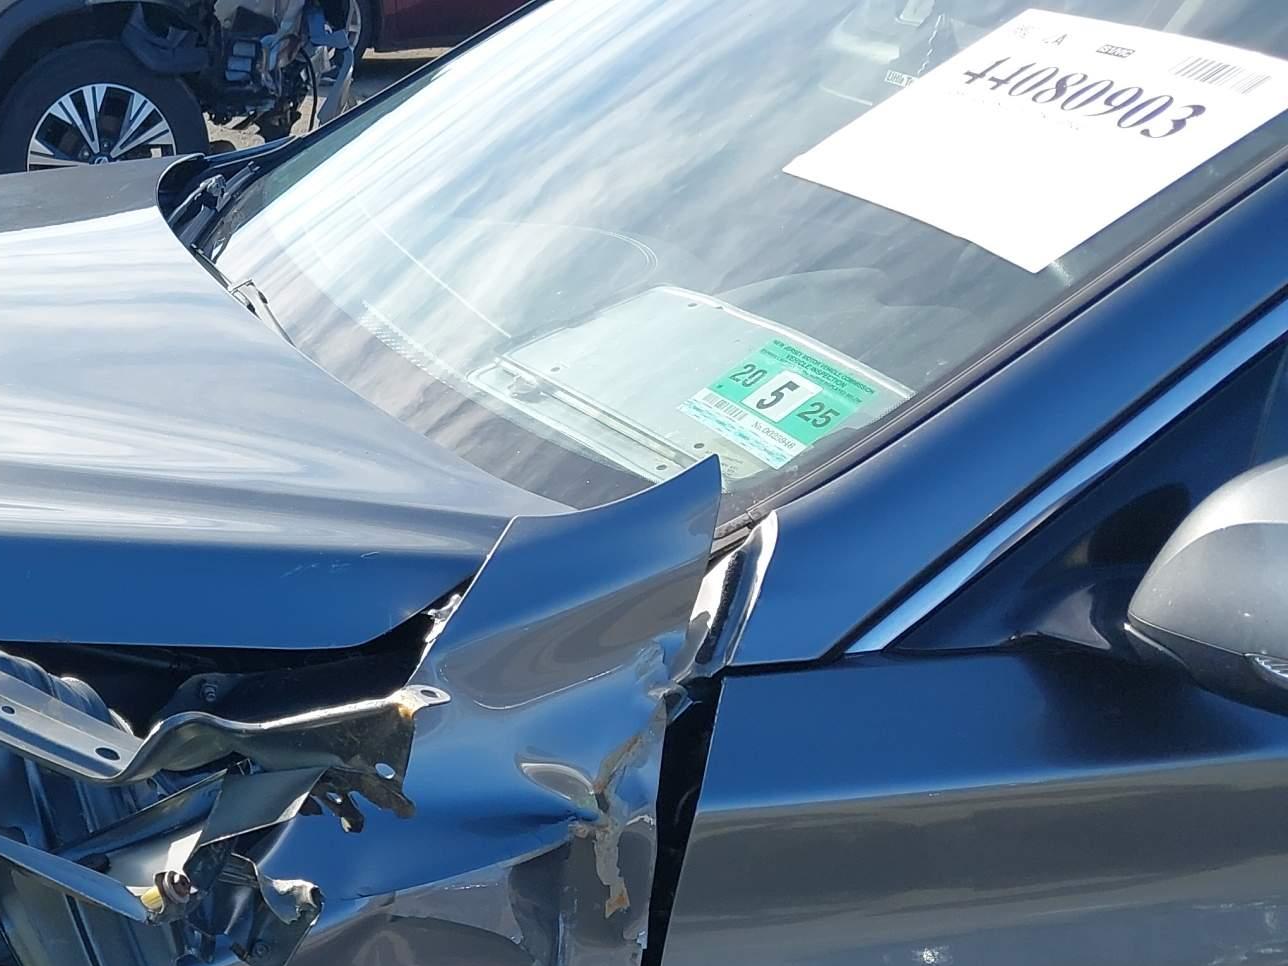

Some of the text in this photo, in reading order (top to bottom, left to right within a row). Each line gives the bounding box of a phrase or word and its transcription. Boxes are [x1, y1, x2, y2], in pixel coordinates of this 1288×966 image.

[963, 57, 1207, 138] 44080903
[728, 363, 768, 388] 20
[755, 380, 801, 410] 5
[796, 401, 841, 428] 25
[811, 365, 848, 389] INSPECTION
